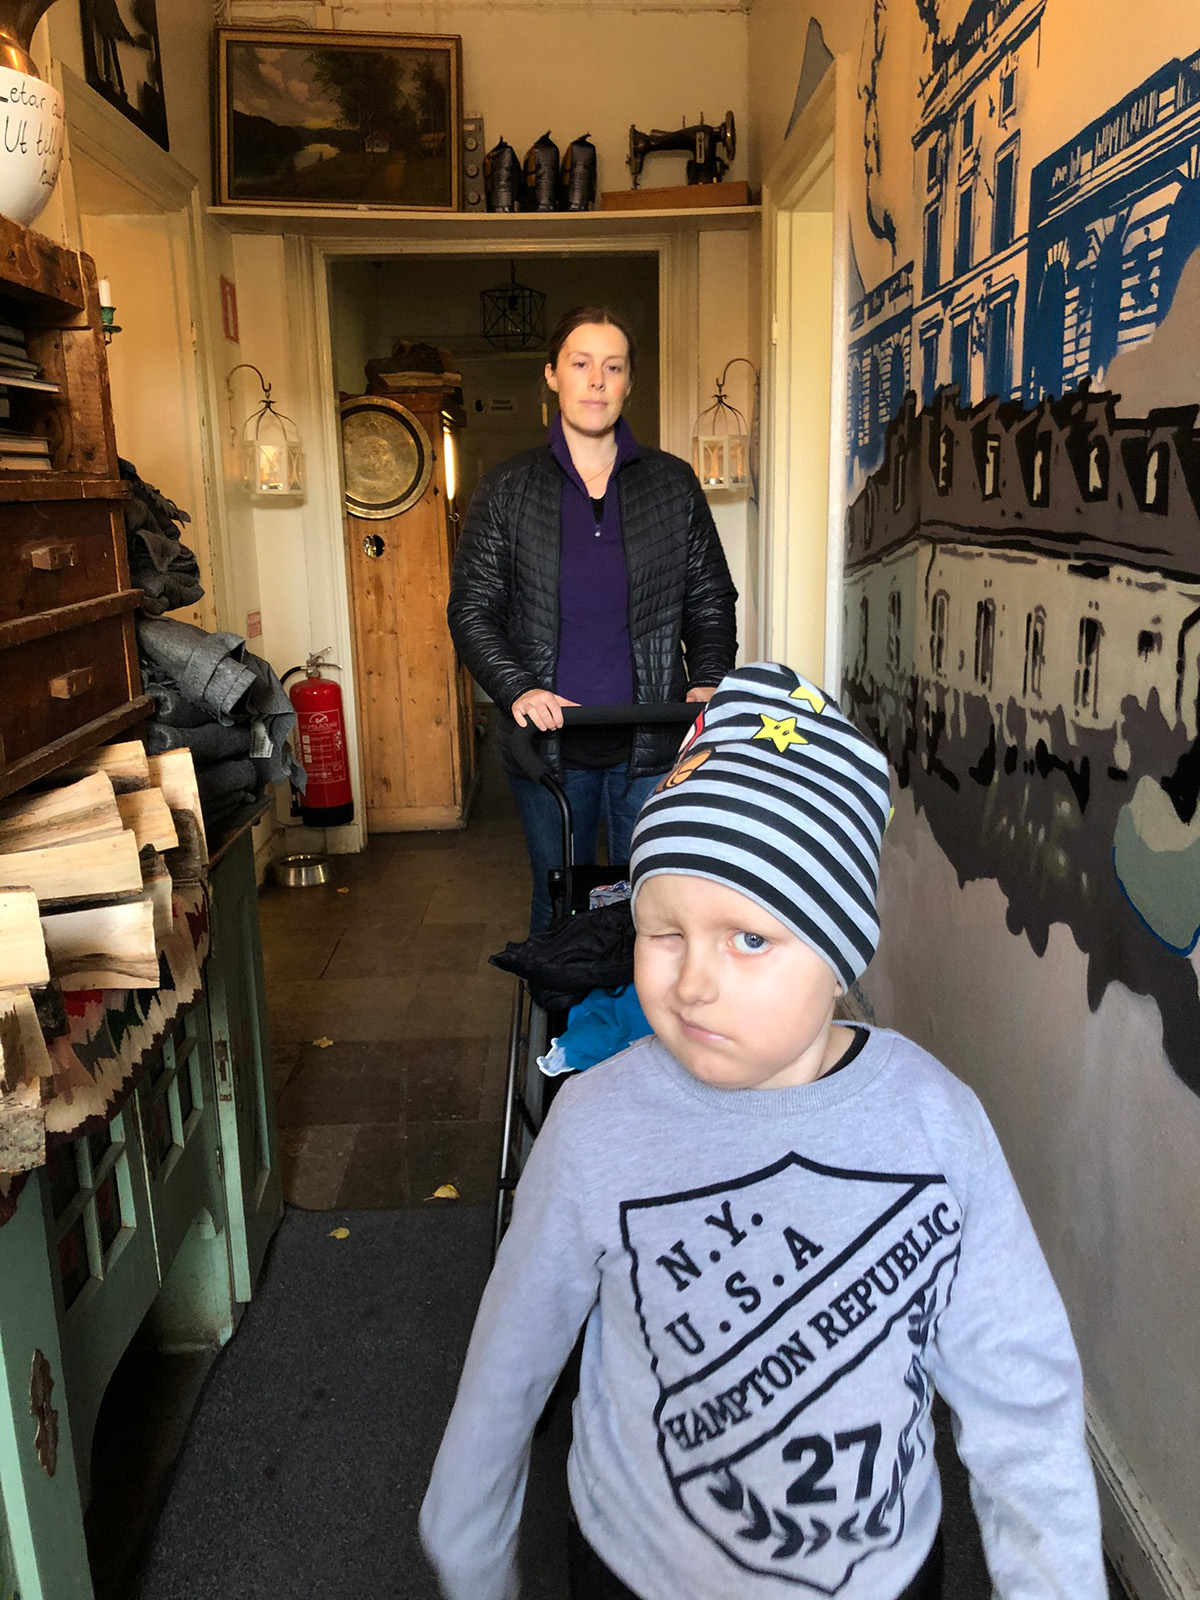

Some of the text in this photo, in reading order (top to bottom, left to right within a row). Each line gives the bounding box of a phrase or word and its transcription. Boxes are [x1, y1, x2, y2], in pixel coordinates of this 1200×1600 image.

[0, 81, 46, 109] etar
[4, 115, 28, 154] Ut
[665, 1201, 961, 1450] HAMPTON REPUBLIC
[782, 1422, 883, 1507] 27
